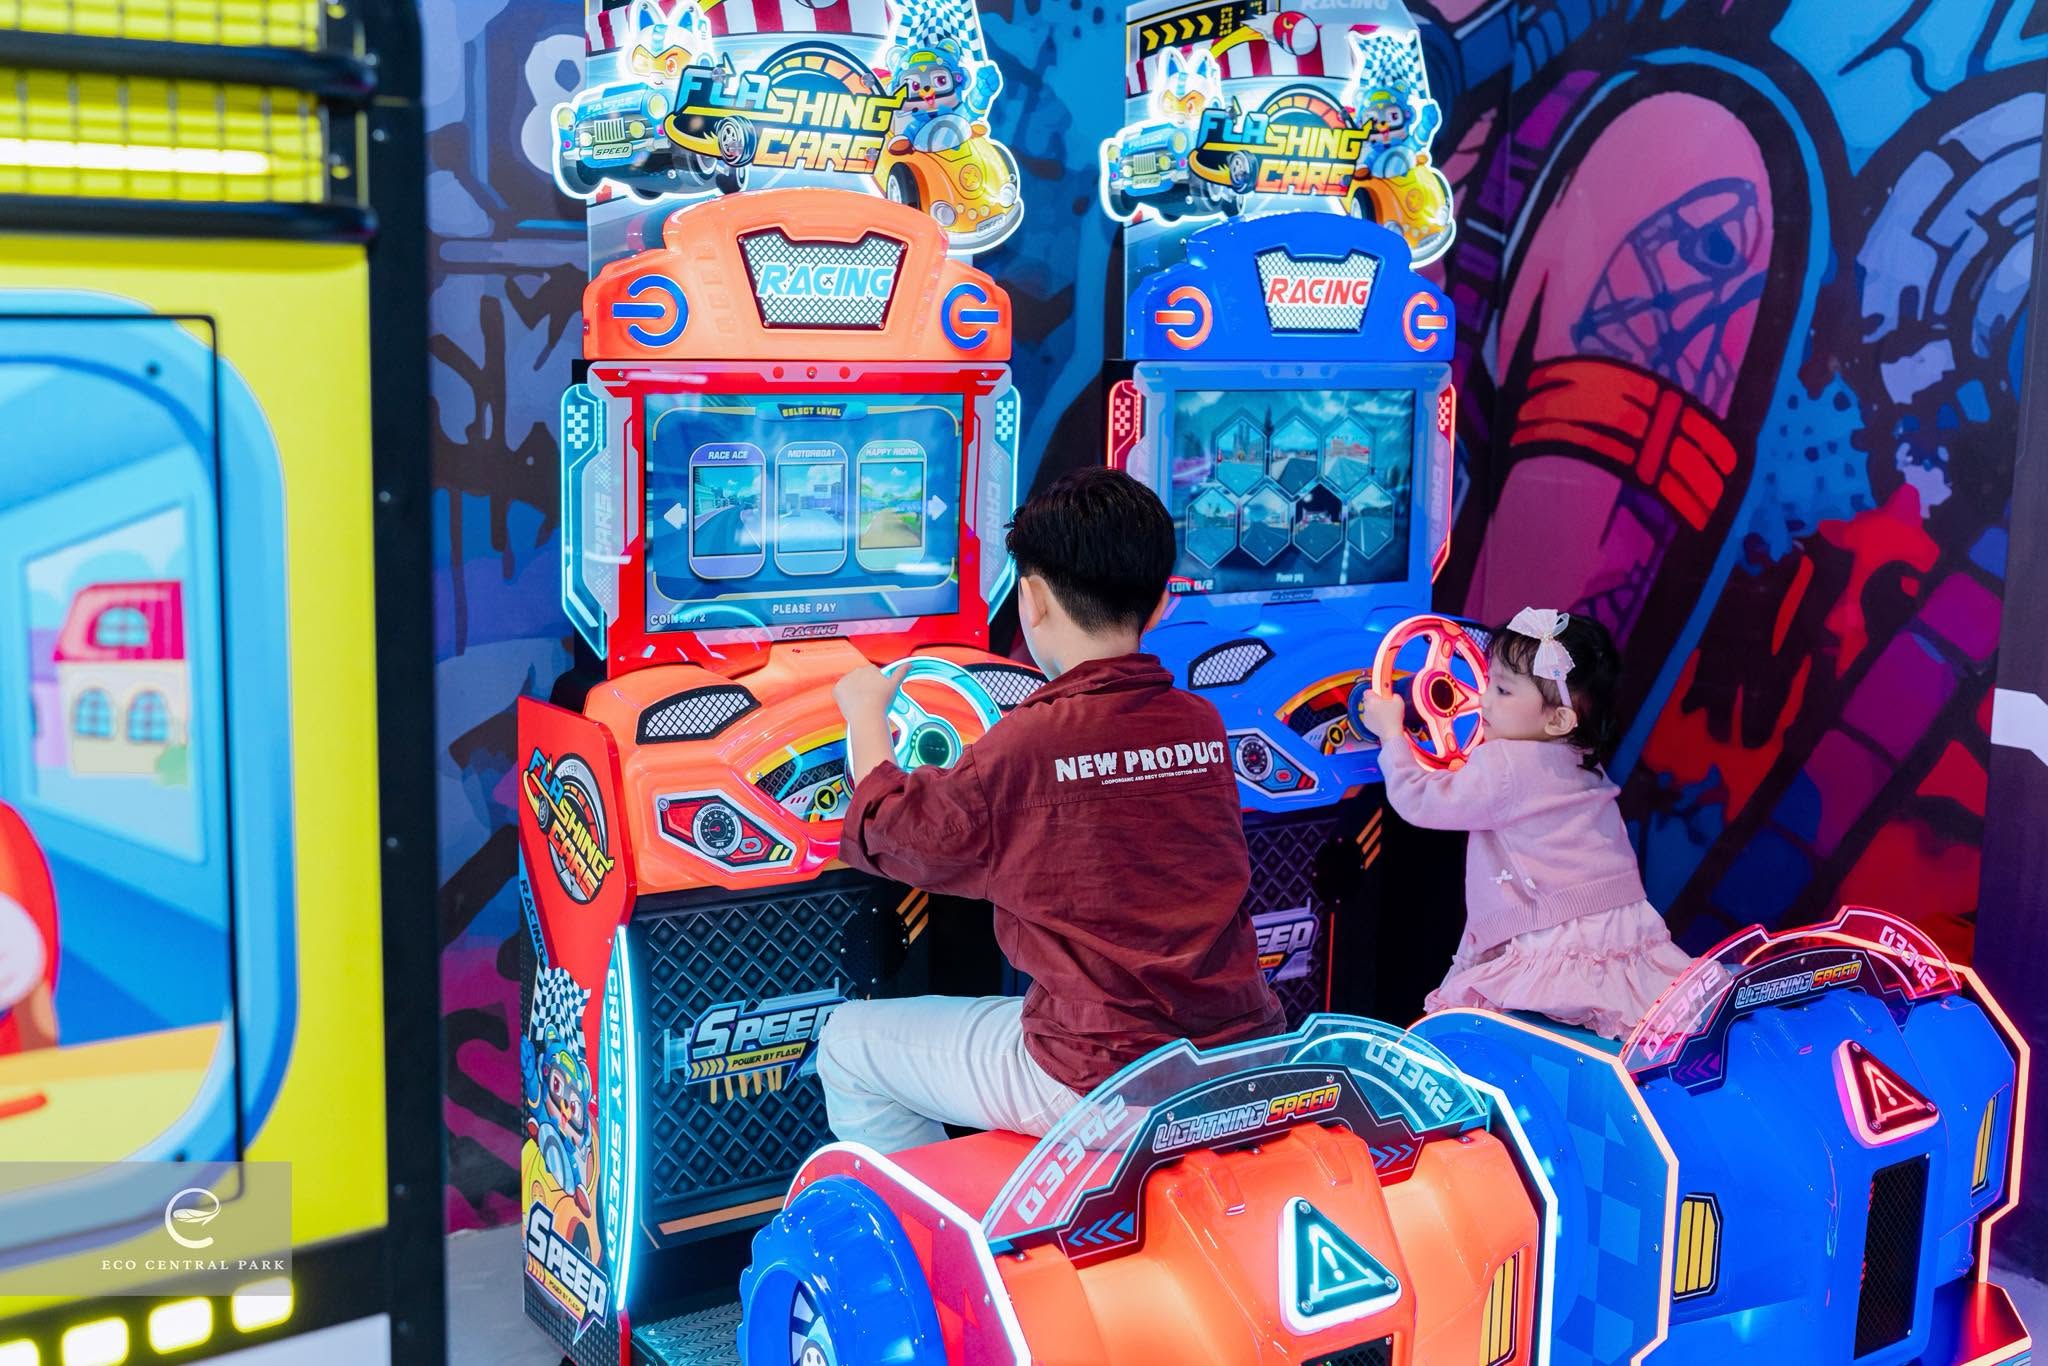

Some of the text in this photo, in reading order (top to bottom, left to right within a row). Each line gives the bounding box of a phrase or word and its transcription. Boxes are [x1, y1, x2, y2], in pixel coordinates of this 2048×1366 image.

[676, 55, 907, 132] FLASHING
[595, 146, 630, 156] SPEED
[753, 128, 885, 174] CARS
[1197, 98, 1373, 160] FLASHING
[1256, 159, 1355, 196] CARS
[757, 264, 895, 298] RACING
[1266, 277, 1370, 305] RACING
[782, 408, 842, 417] SELECT LEVEL
[708, 450, 748, 460] RACE ACE
[772, 603, 837, 614] PLEASE PAY
[782, 624, 839, 638] RACING
[1054, 741, 1224, 782] NEW PRODUCT
[528, 749, 614, 879] FLASHING
[548, 819, 598, 900] CARS
[520, 879, 546, 959] RACING
[1735, 961, 1861, 1007] LIGHTNING SPEED
[608, 968, 622, 1112] CRAZY
[732, 1047, 802, 1067] POWER BY FLASH
[1154, 1086, 1340, 1150] LIGHTNING SPEED
[606, 1120, 622, 1262] SPEED
[527, 1208, 607, 1318] SPEED
